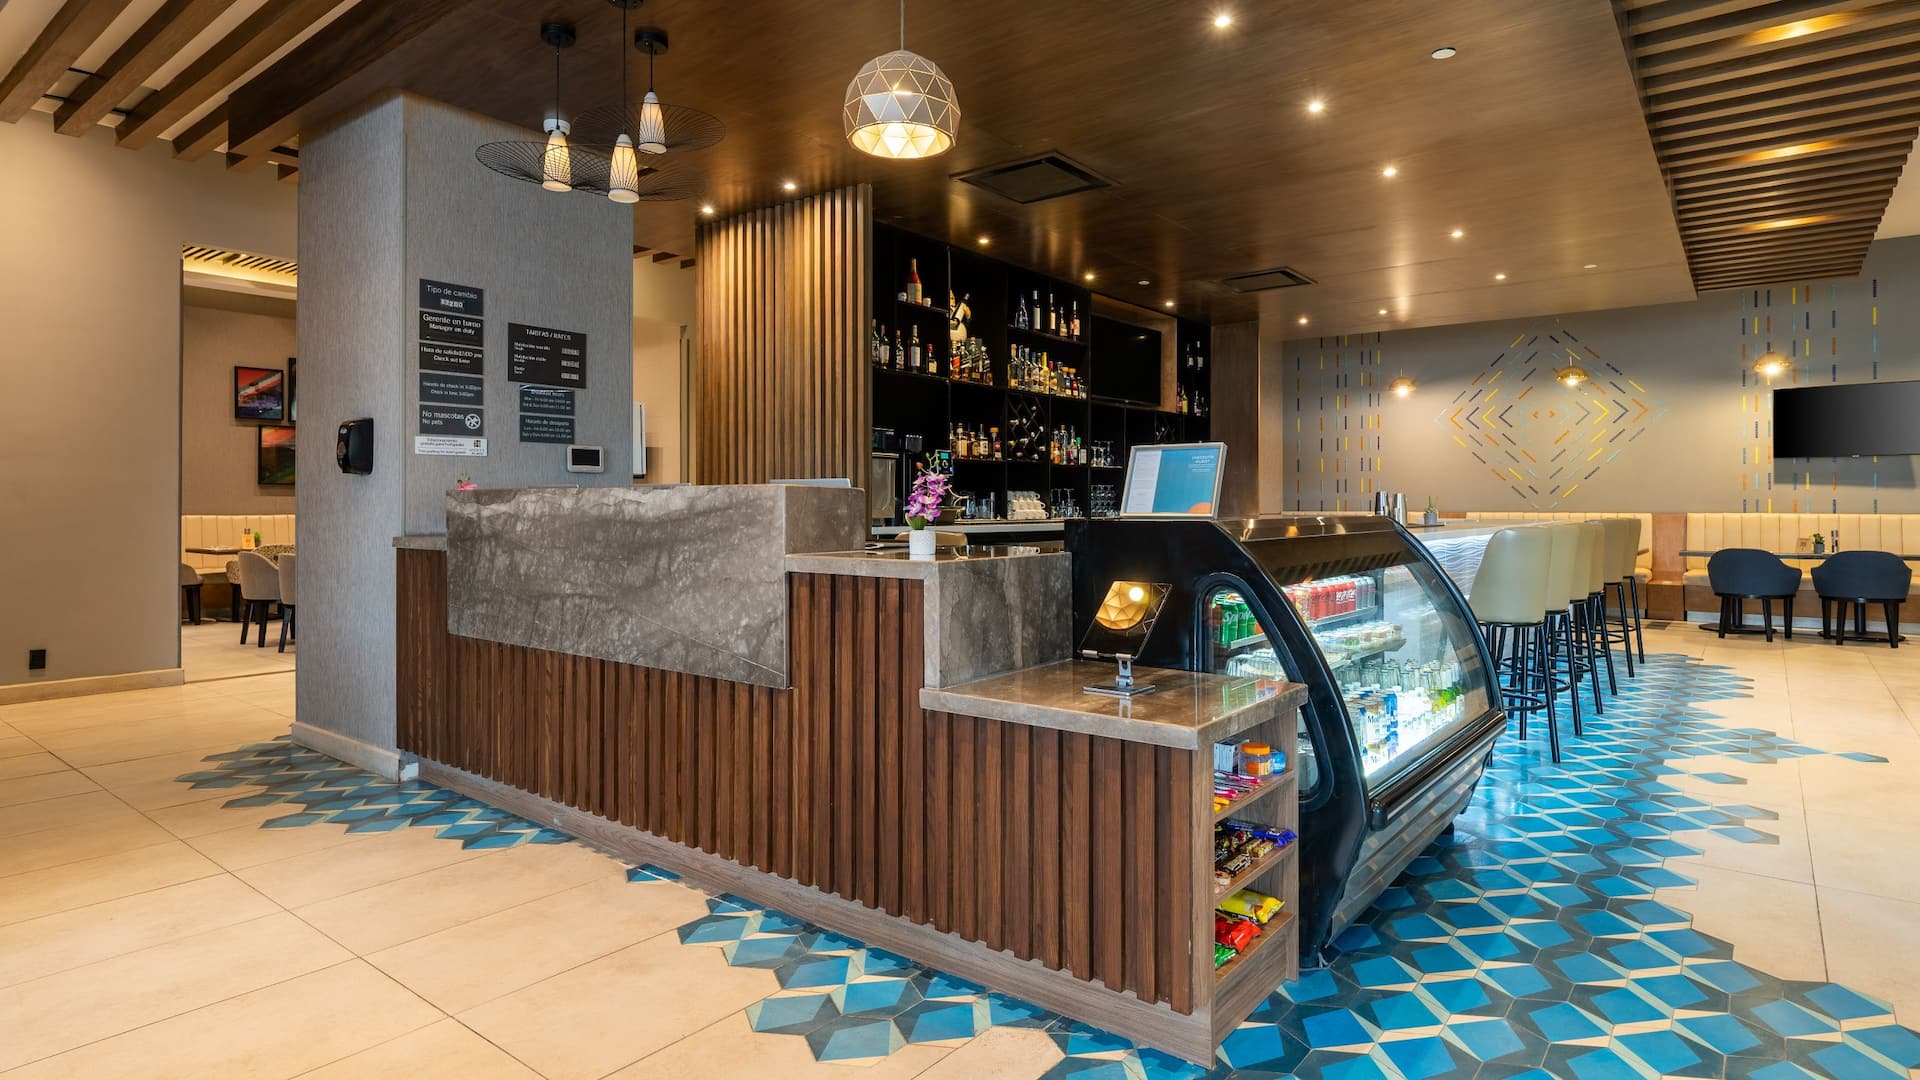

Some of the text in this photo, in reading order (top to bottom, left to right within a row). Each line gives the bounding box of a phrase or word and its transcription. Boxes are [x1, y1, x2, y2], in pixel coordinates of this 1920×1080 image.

[427, 285, 478, 300] Tipo de cambio
[423, 313, 450, 324] Gerente
[462, 320, 481, 328] turno
[422, 410, 464, 420] No mascotas
